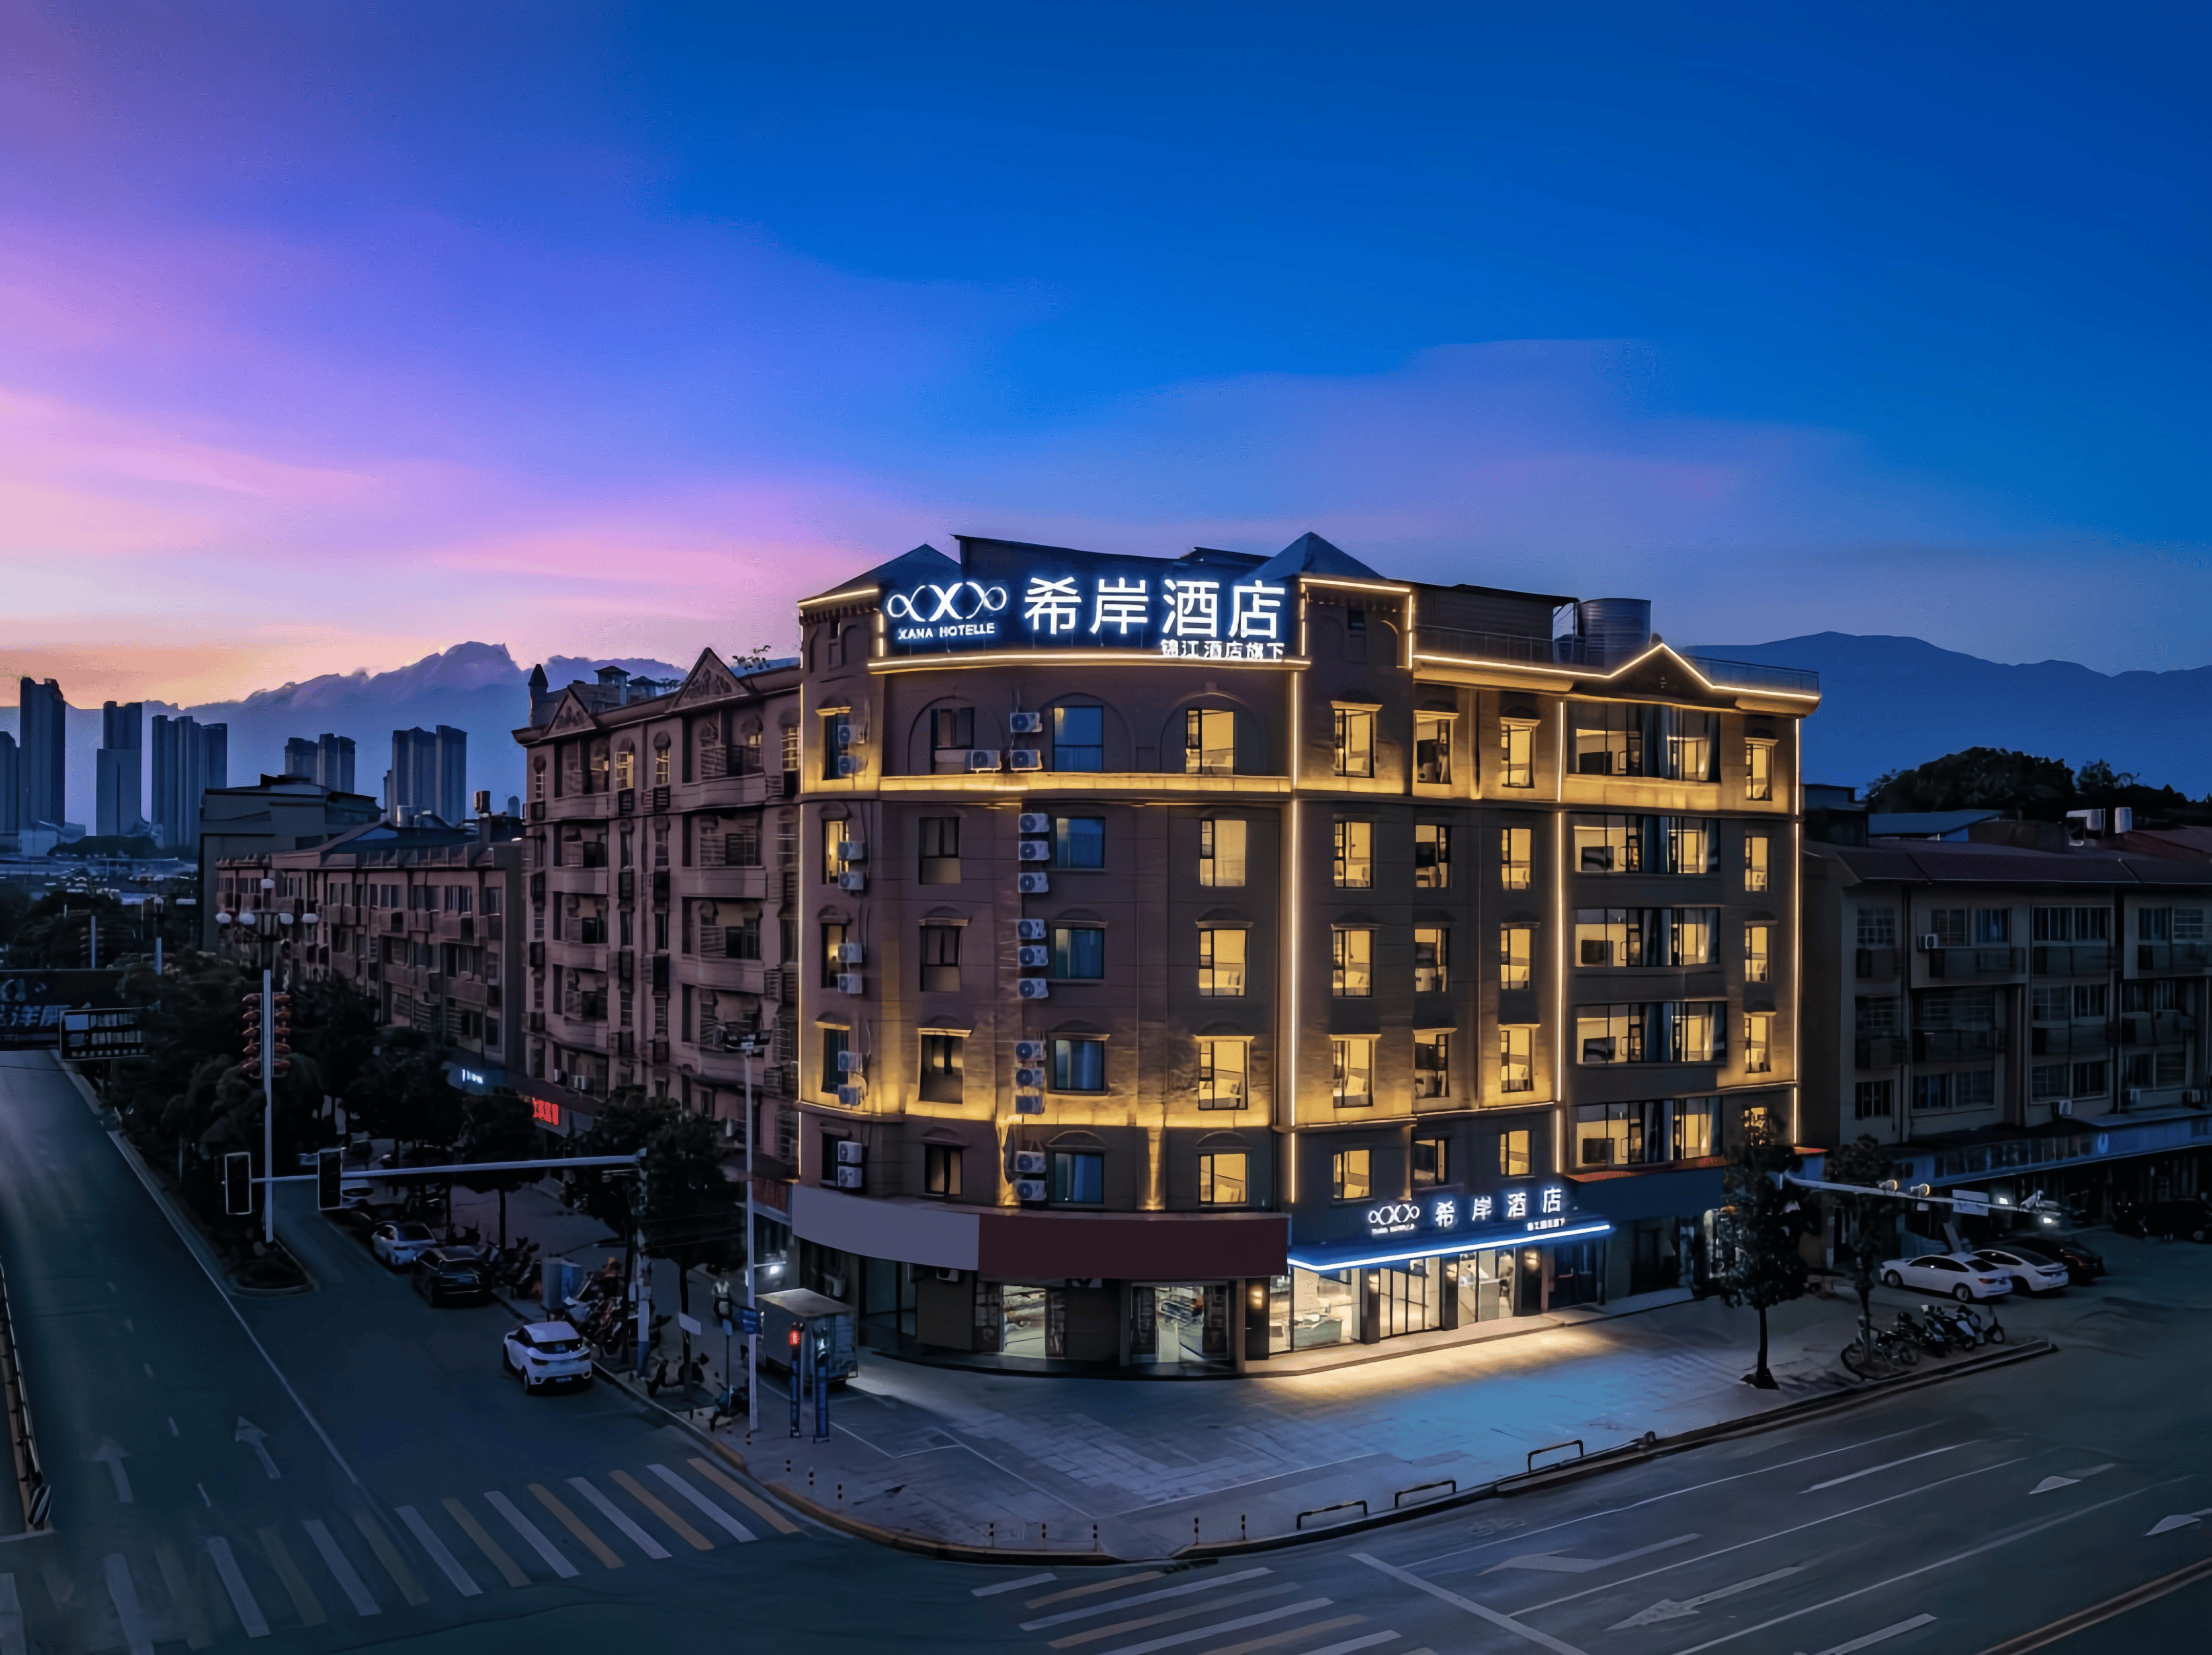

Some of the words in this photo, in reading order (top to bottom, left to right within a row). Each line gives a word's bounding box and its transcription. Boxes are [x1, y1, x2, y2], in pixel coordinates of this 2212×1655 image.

[1024, 577, 1286, 639] 希岸酒店
[898, 628, 933, 640] XANA
[939, 623, 995, 638] HOTELLE
[1435, 1187, 1562, 1227] 希岸酒店
